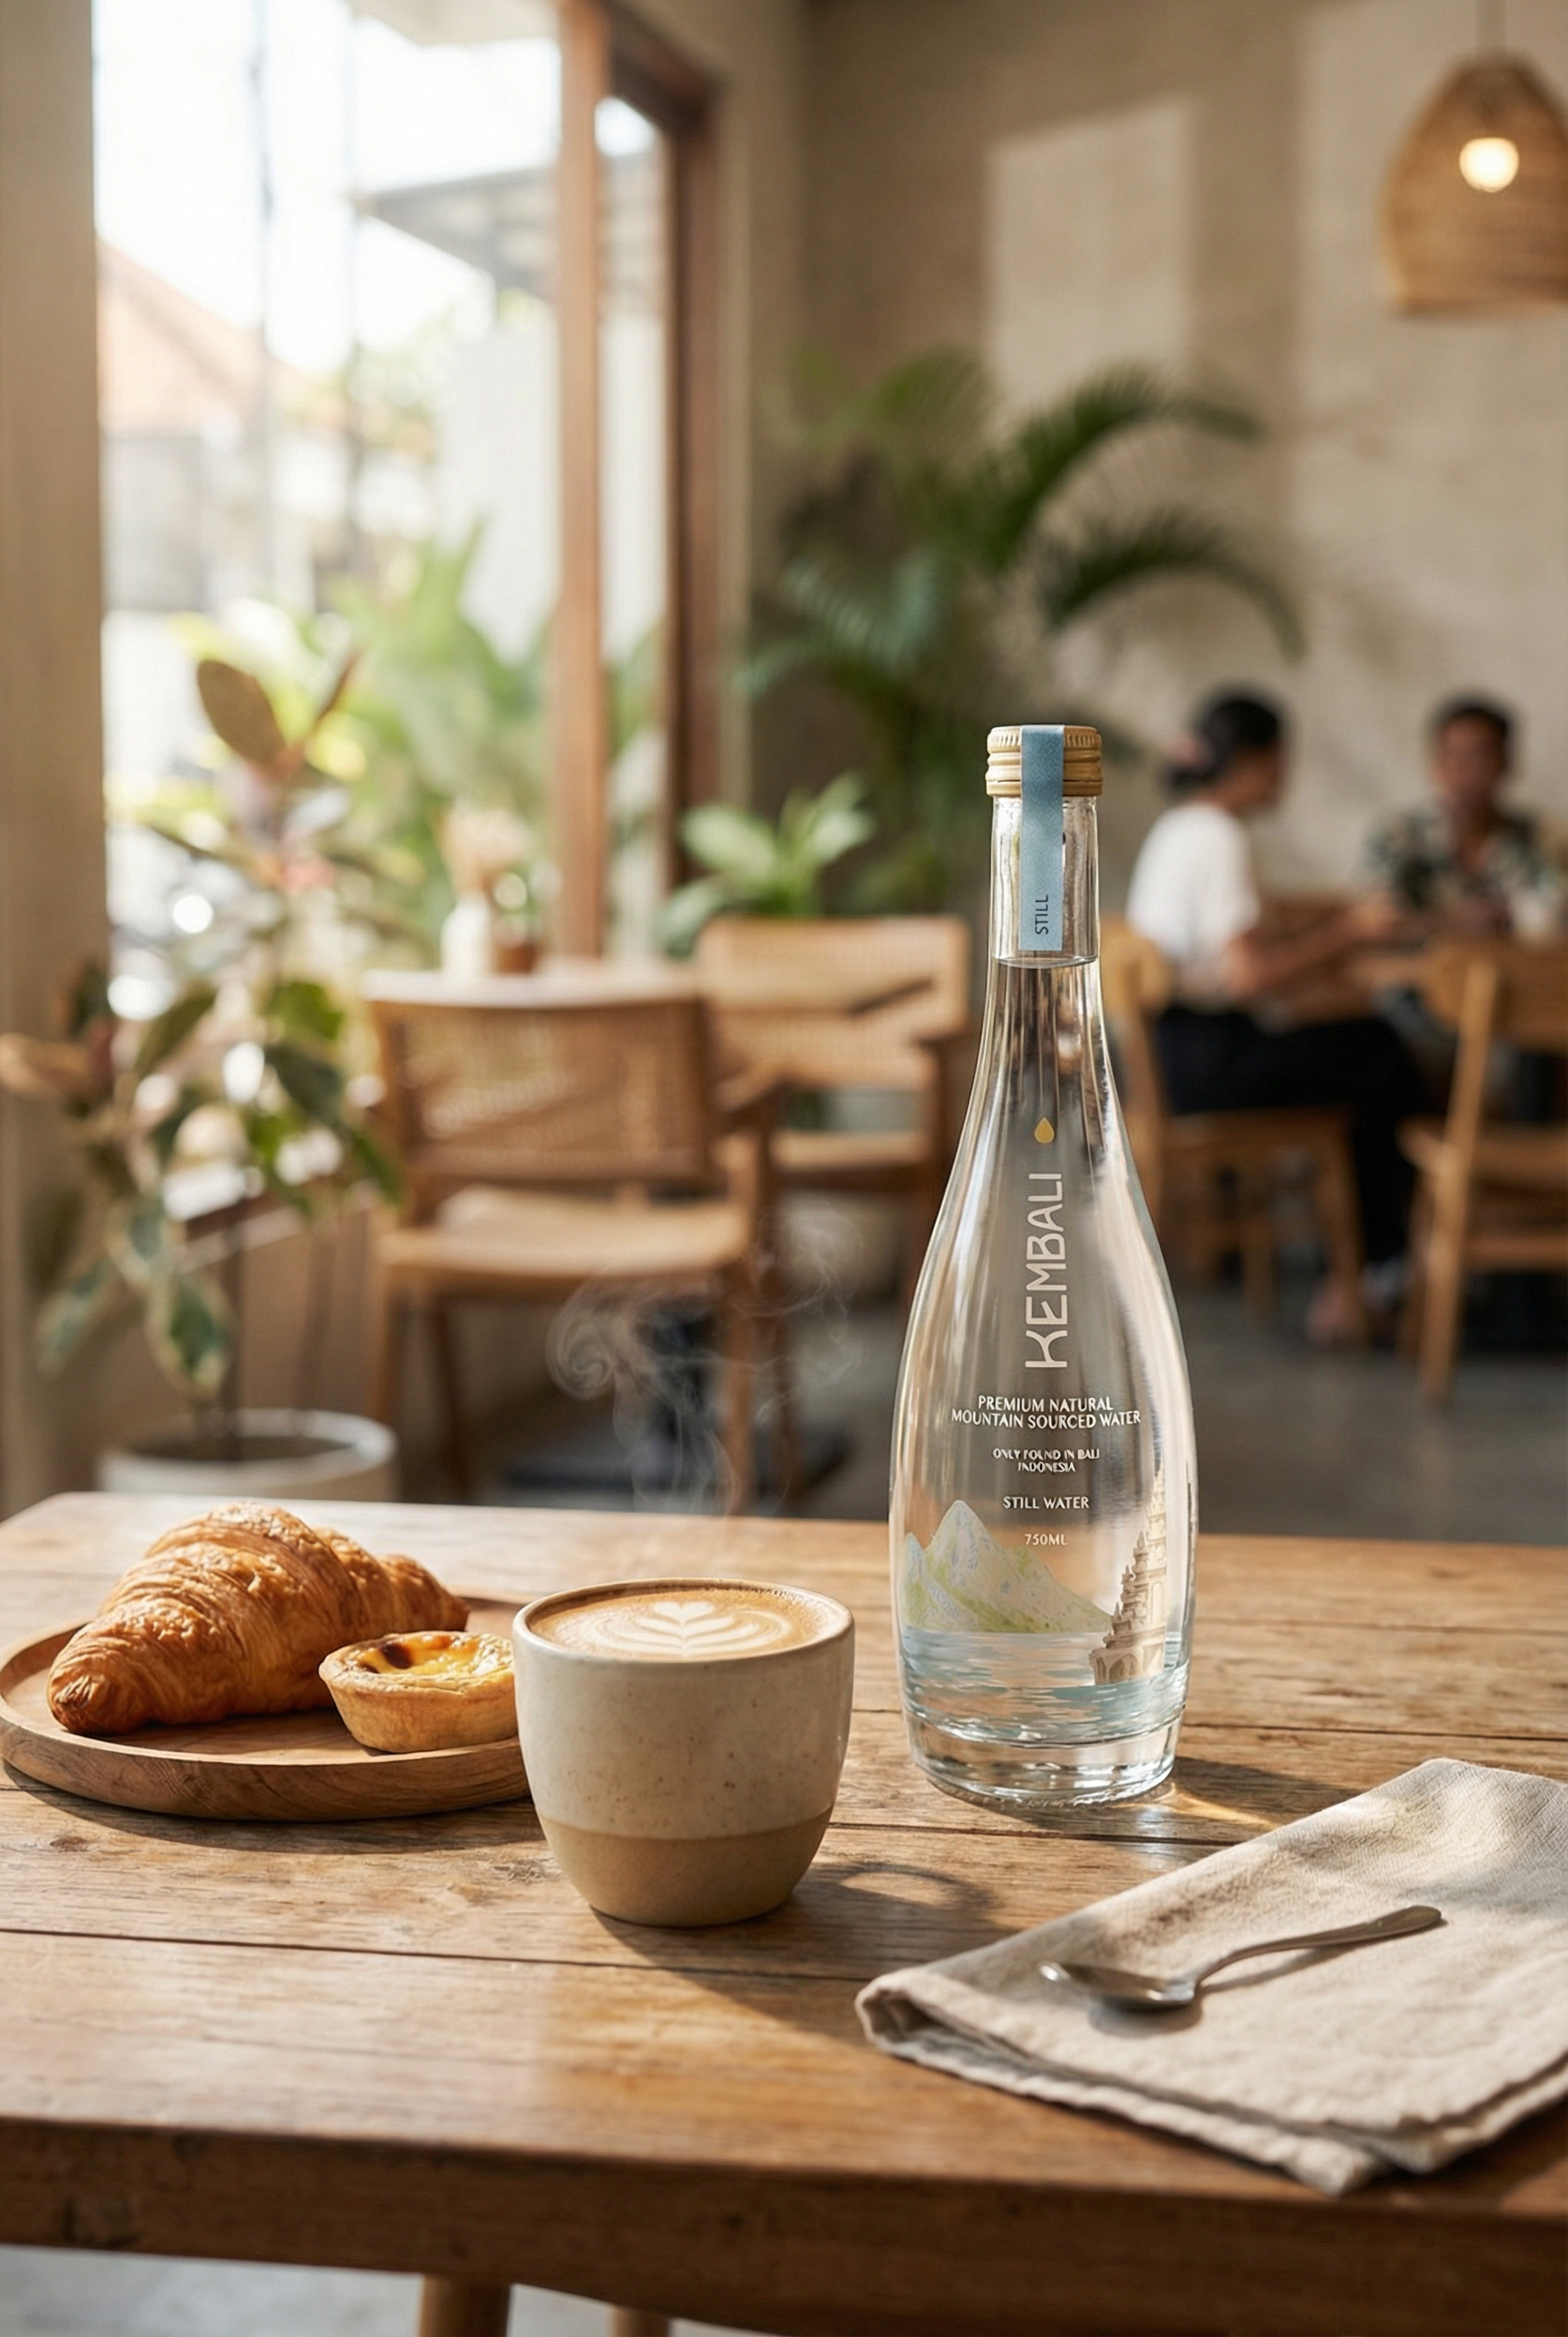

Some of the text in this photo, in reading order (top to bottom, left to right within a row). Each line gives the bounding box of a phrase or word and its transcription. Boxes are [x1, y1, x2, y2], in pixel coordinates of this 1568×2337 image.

[1035, 894, 1049, 935] STILL
[1024, 1173, 1068, 1368] KEMBALI
[978, 1395, 1114, 1413] PREMIUM NATURAL
[951, 1408, 1141, 1429] MOUNTAIN SOURCED WATER
[992, 1448, 1021, 1460] ONLY
[1063, 1449, 1075, 1460] IN
[1018, 1462, 1076, 1474] INDONESIA
[1003, 1496, 1090, 1510] STILL WATER
[1024, 1533, 1069, 1546] 750ML
